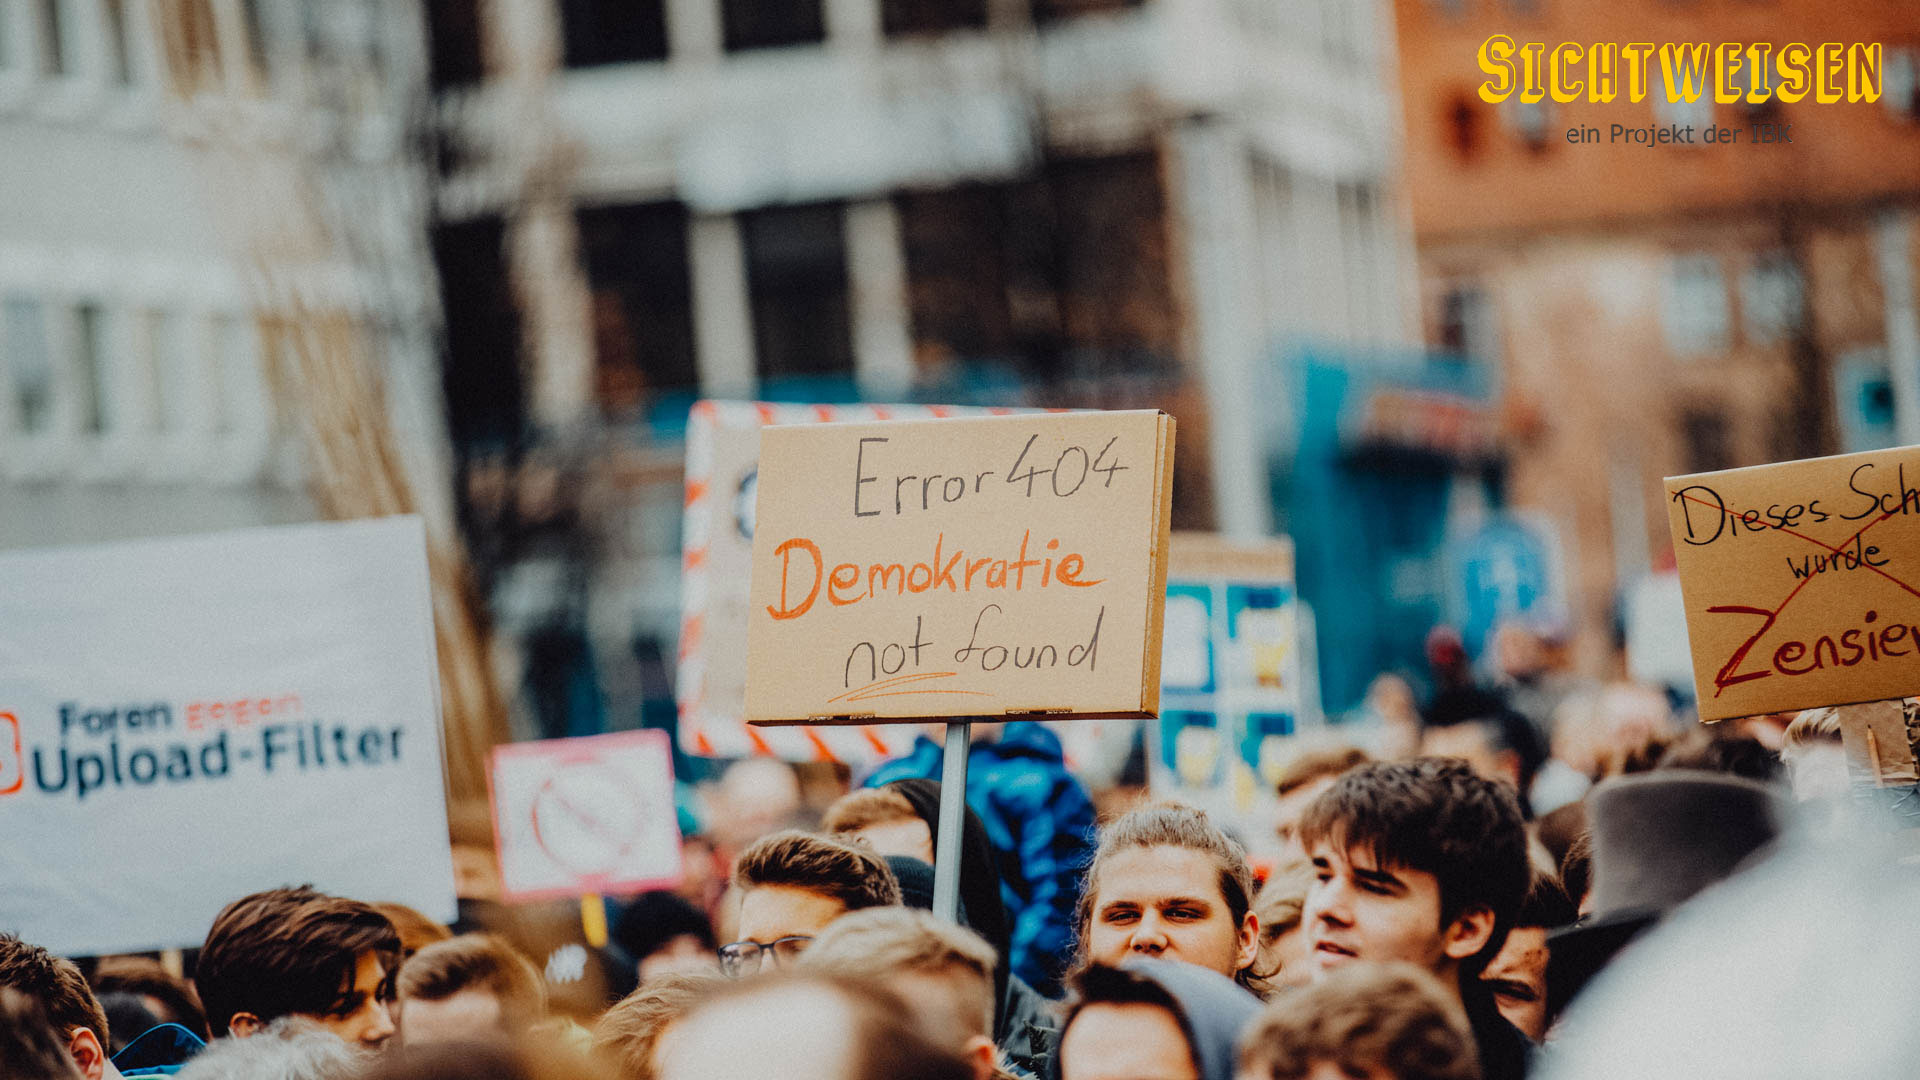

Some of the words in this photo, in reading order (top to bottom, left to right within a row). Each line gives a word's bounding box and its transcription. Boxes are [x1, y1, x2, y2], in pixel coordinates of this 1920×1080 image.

[854, 437, 994, 517] Error
[1007, 434, 1129, 498] 404
[1673, 485, 1831, 546] Dieses
[766, 529, 1106, 620] Demokratie
[1787, 532, 1890, 579] wurde
[845, 616, 934, 688] not
[954, 604, 1105, 672] found
[58, 702, 172, 735] Foren
[32, 722, 404, 800] Upload-Filter
